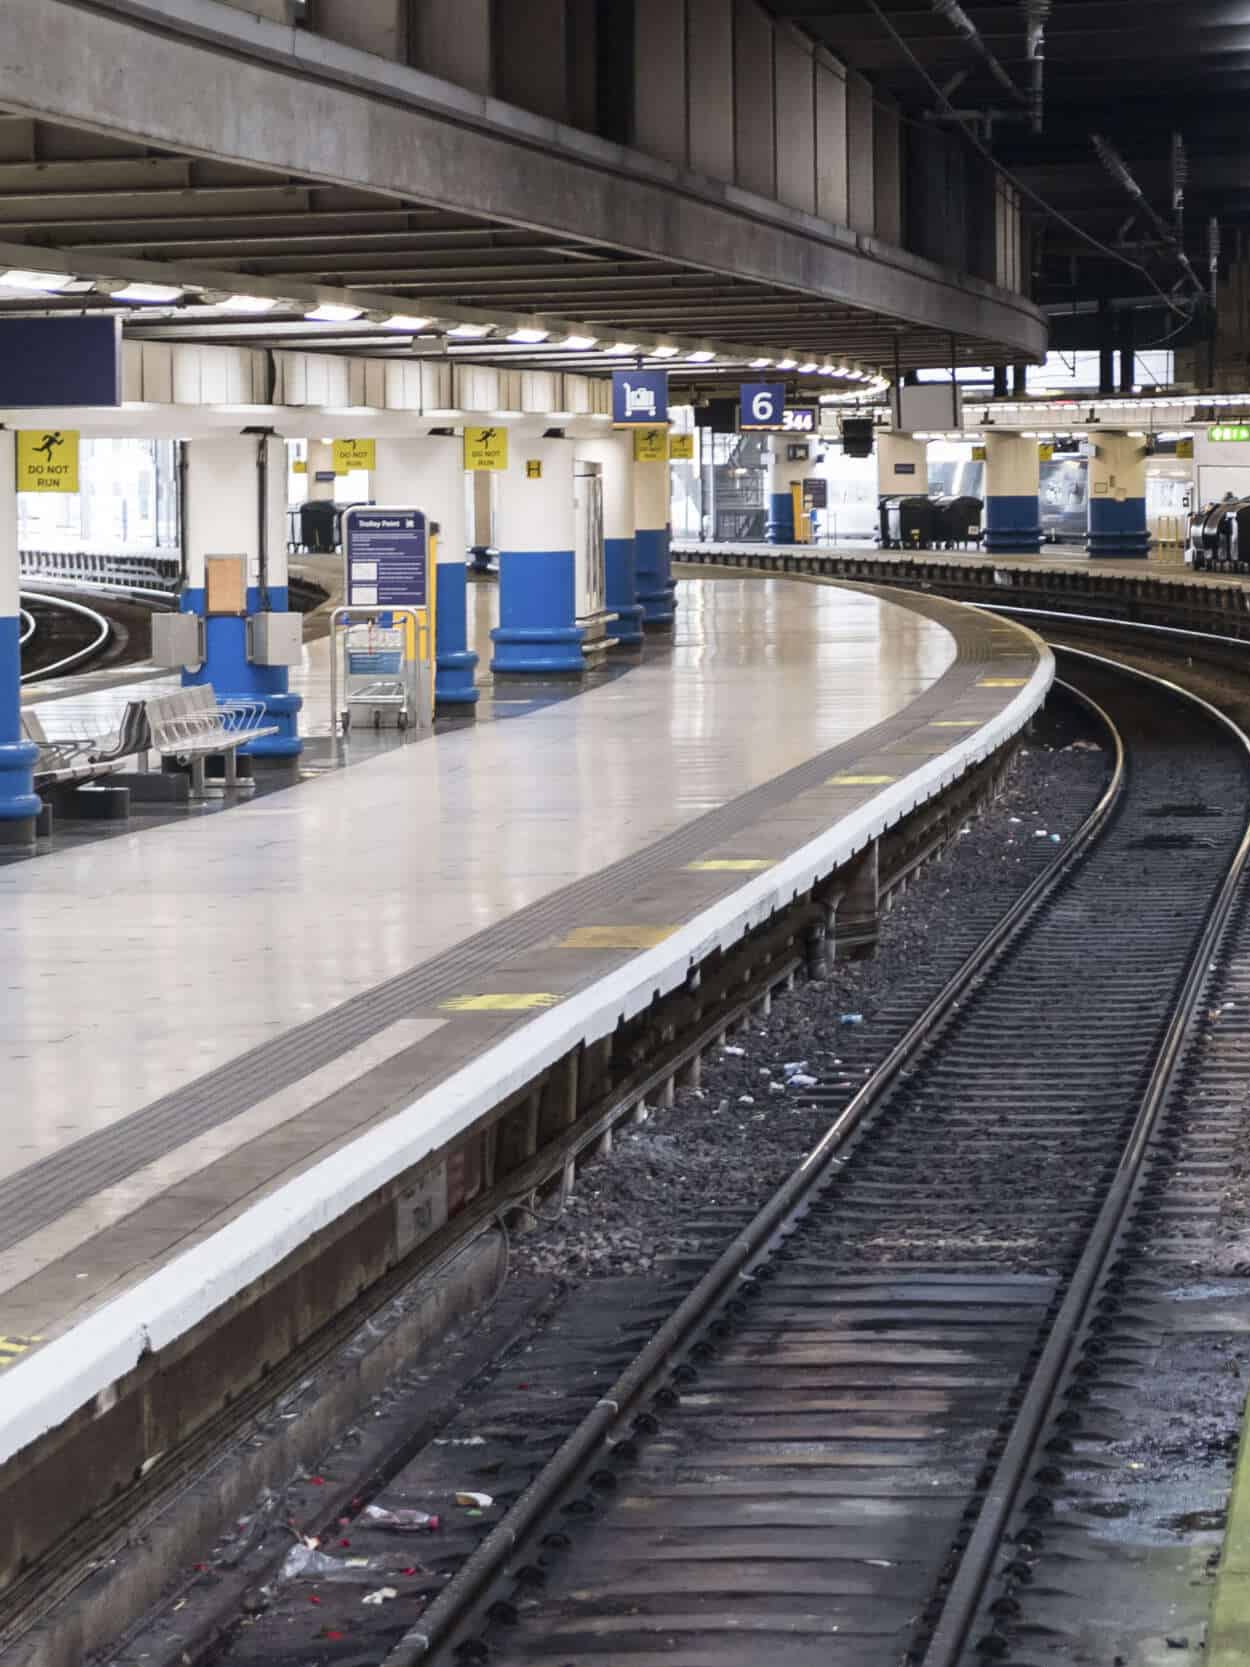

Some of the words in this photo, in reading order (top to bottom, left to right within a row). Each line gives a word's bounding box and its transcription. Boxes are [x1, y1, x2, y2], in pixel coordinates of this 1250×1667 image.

[752, 392, 773, 420] 6
[28, 465, 44, 474] DO
[47, 465, 69, 473] NOT
[37, 478, 61, 487] RUN
